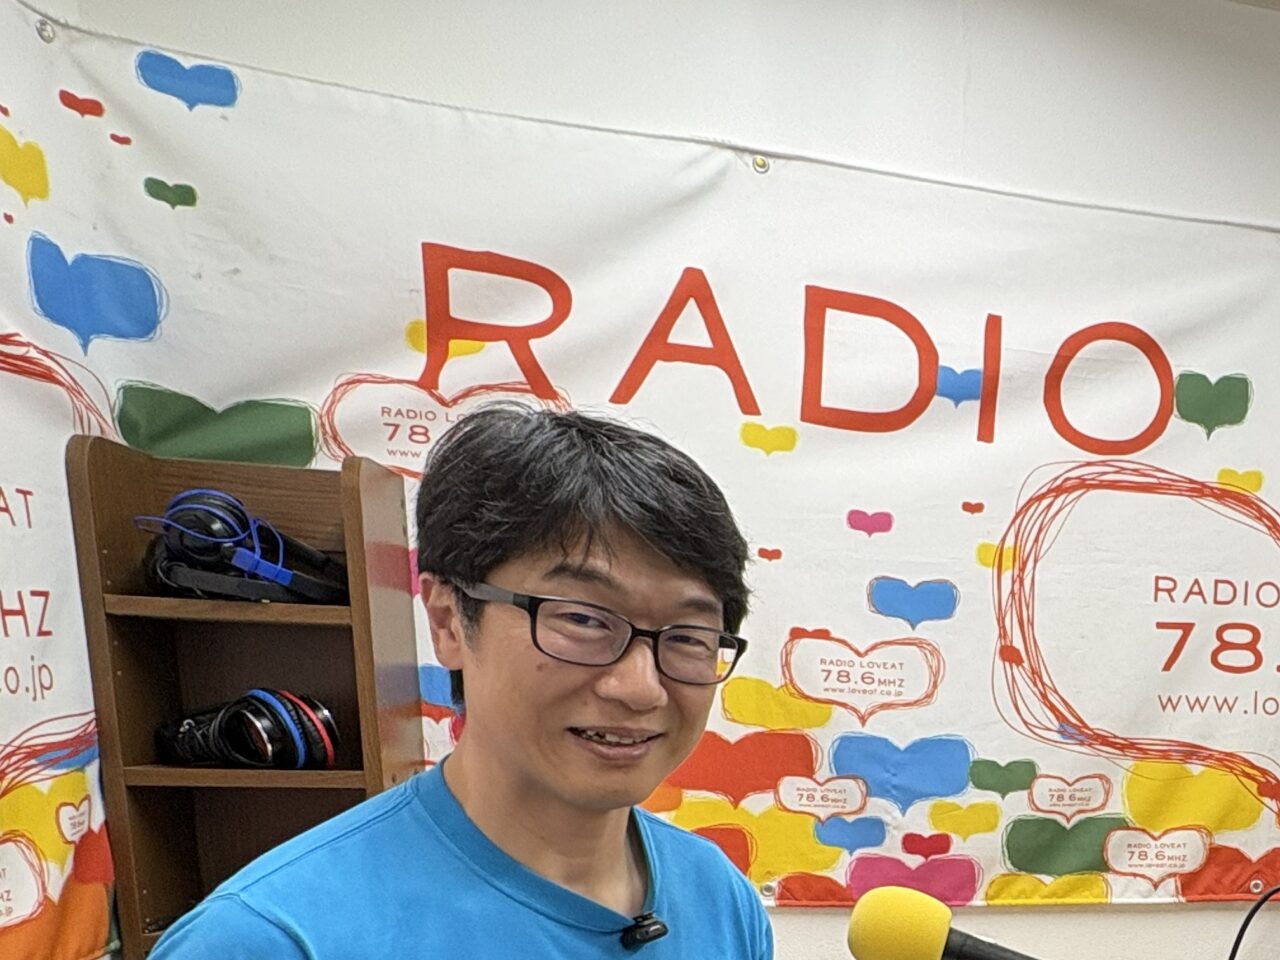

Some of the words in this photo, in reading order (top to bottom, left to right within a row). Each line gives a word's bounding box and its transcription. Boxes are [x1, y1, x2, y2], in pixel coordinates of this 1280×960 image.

[421, 241, 1175, 456] RADIO
[381, 406, 437, 421] RADIO
[820, 658, 855, 668] RADIO
[860, 661, 904, 670] LOVEAT
[821, 669, 875, 685] 78.6
[877, 678, 905, 688] MHZ
[1128, 851, 1166, 861] 78.6
